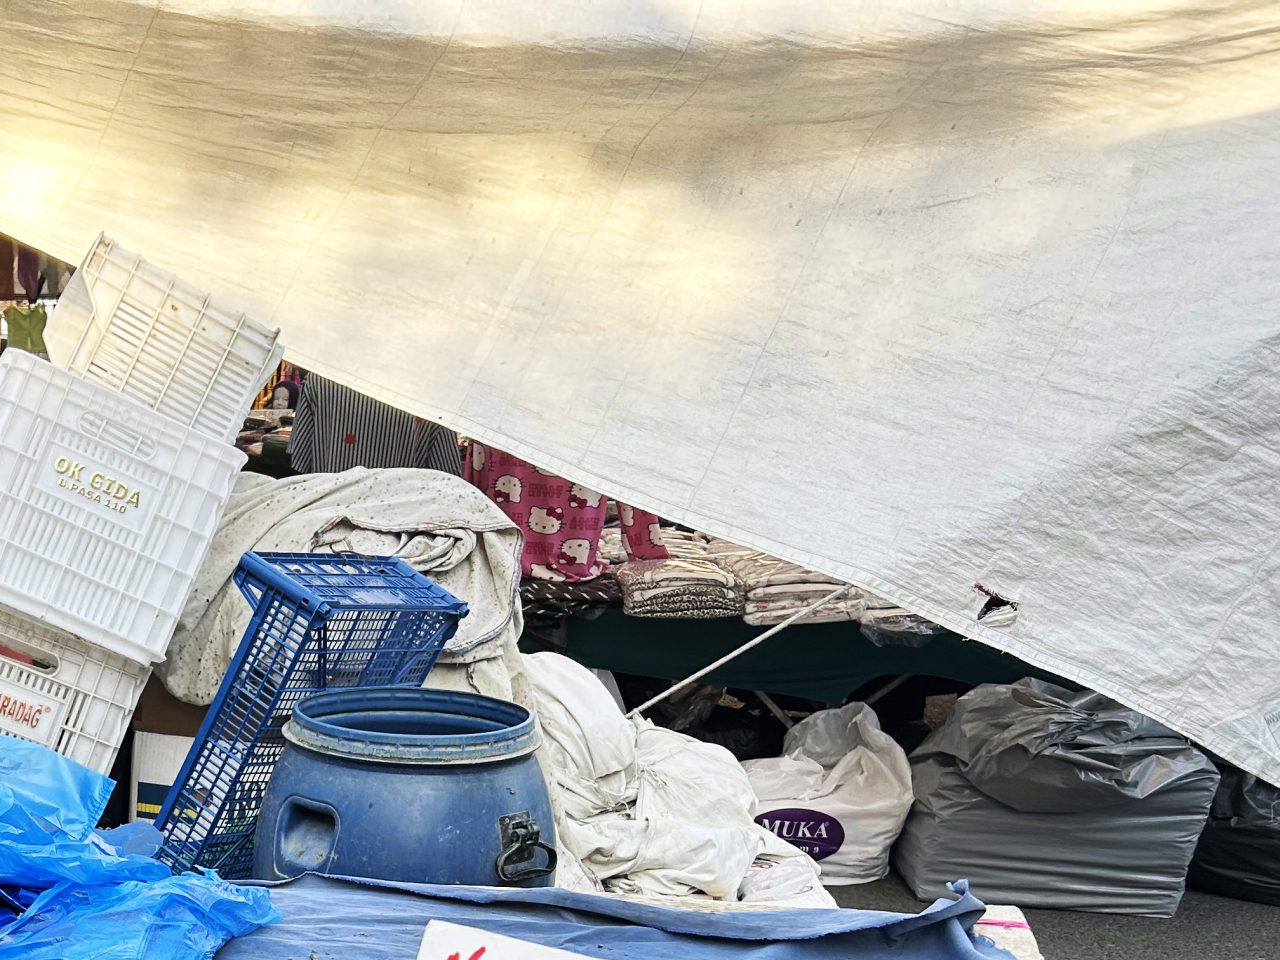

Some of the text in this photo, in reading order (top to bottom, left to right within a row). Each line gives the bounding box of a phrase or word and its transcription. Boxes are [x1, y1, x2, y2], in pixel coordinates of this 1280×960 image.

[53, 455, 141, 509] OK GIDA
[104, 499, 127, 515] 110
[761, 818, 828, 838] MUKA
